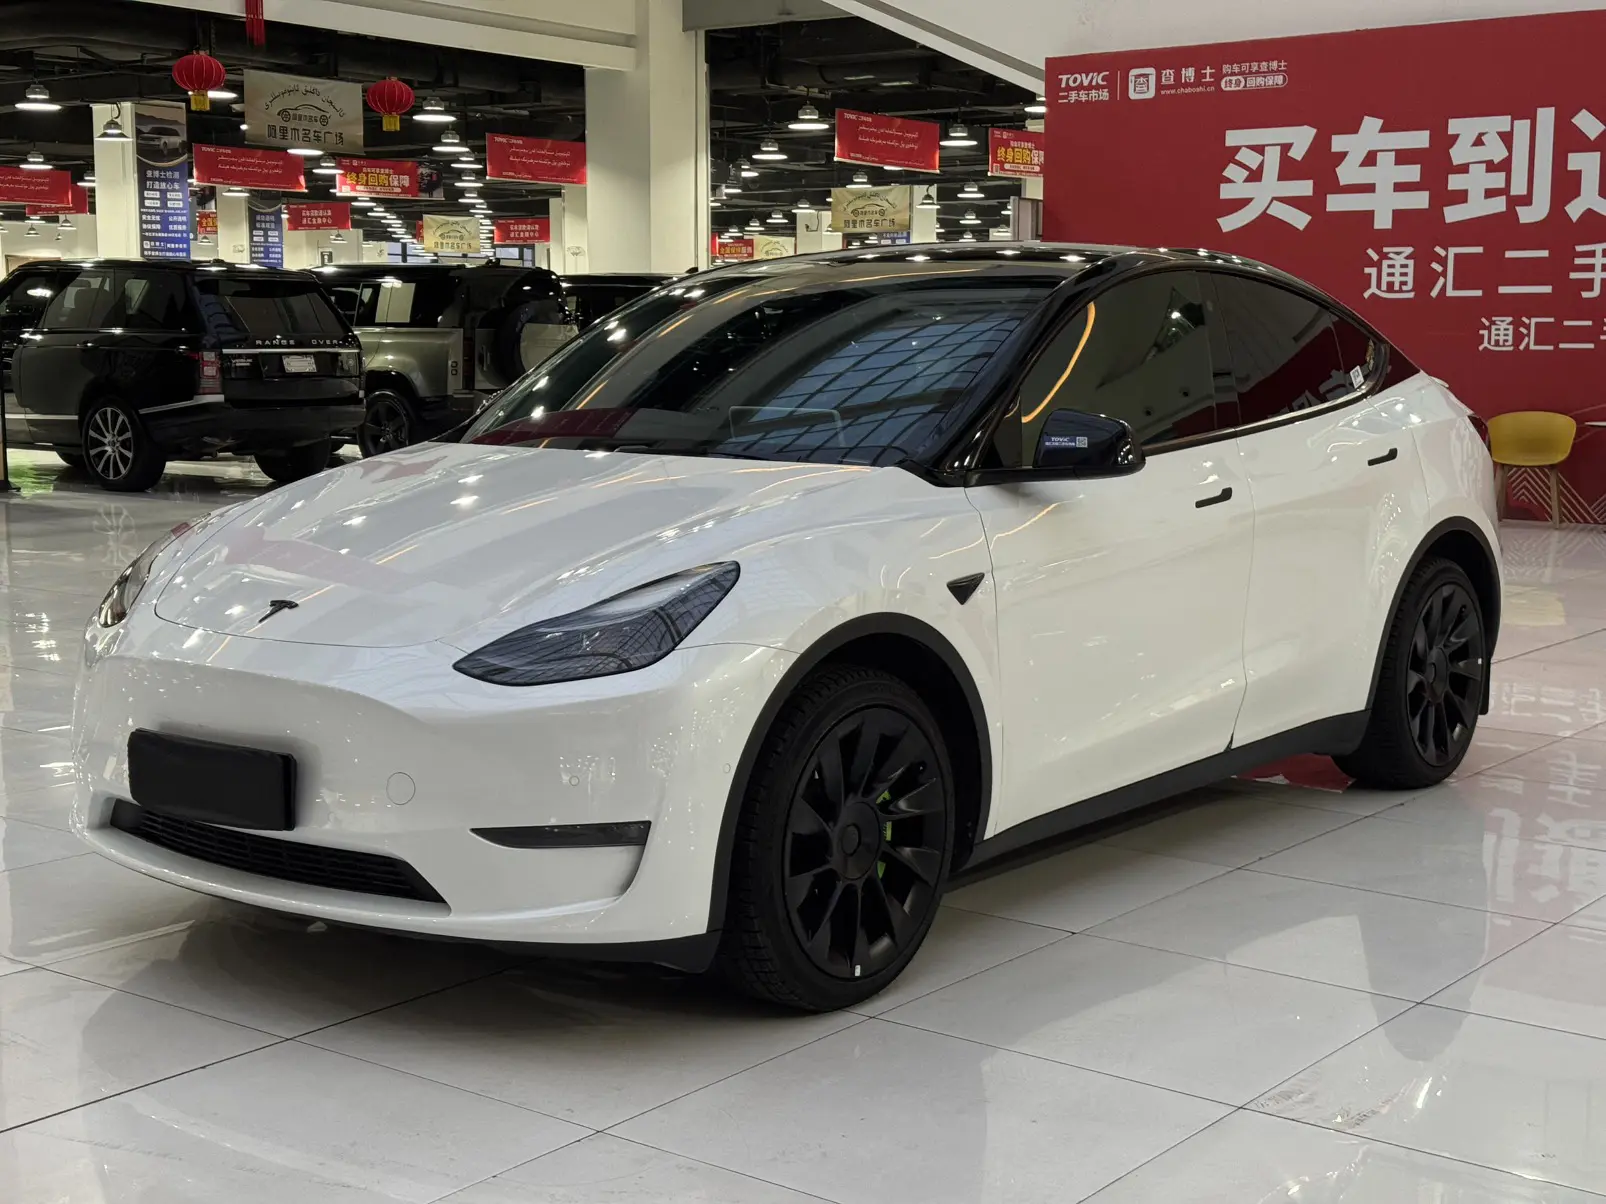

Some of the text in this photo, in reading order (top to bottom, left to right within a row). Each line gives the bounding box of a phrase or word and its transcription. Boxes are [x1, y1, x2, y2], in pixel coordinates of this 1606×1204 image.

[1160, 65, 1216, 85] 查博士
[1222, 59, 1288, 75] 购车可享查博士
[1058, 71, 1110, 89] TOVIC
[1058, 89, 1110, 104] 二手车市场
[1160, 85, 1216, 96] www.chaboshi.cn
[346, 171, 410, 188] 终身回购保障
[1363, 243, 1606, 299] 通汇二手
[1478, 315, 1606, 352] 通汇二
